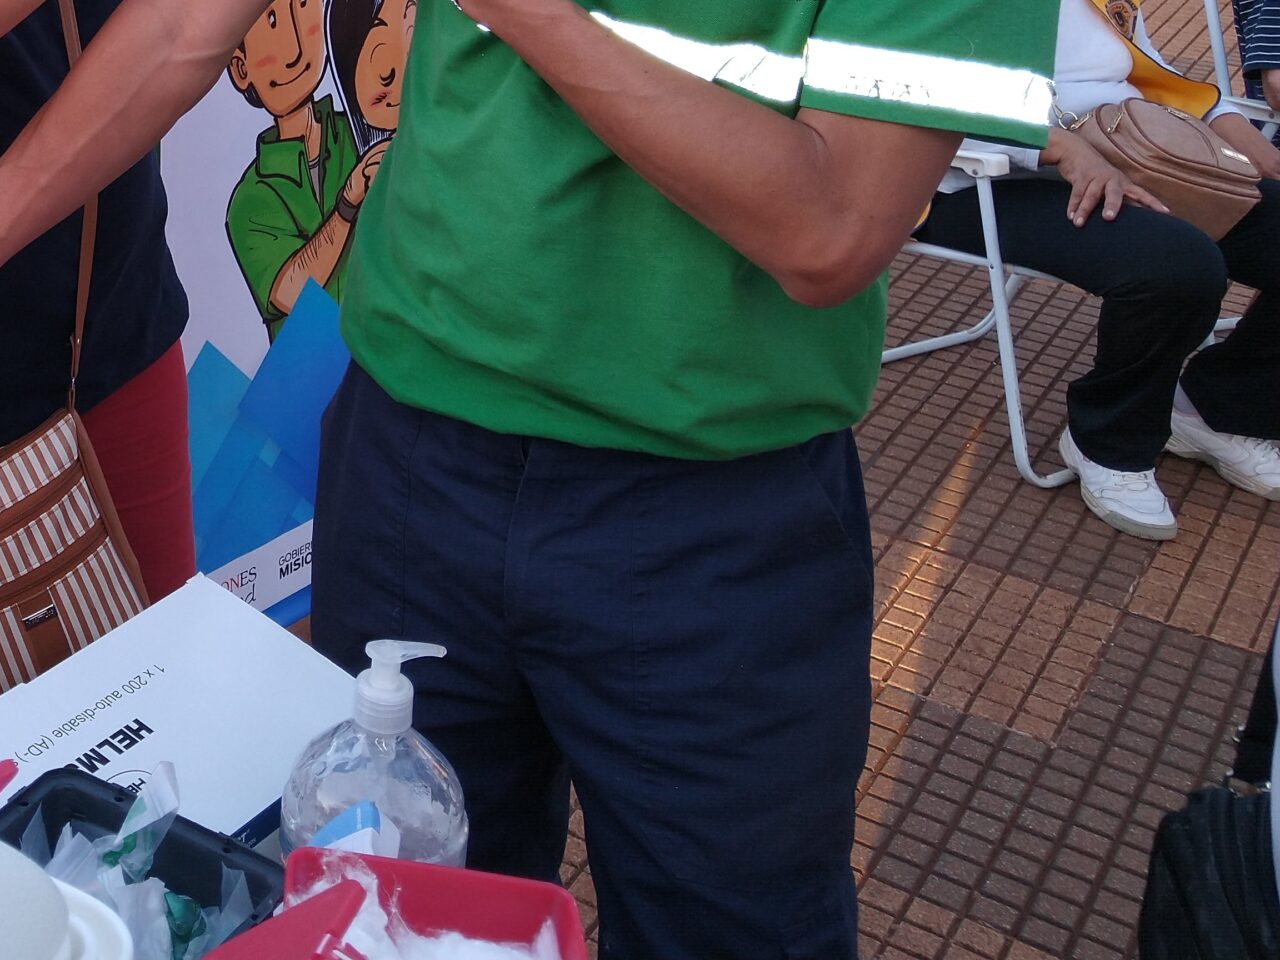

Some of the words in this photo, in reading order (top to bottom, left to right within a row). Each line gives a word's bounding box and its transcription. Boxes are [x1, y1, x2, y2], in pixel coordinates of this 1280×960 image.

[142, 669, 155, 678] x
[153, 663, 166, 673] 1
[122, 675, 148, 695] 200
[51, 690, 123, 738] auto-disable
